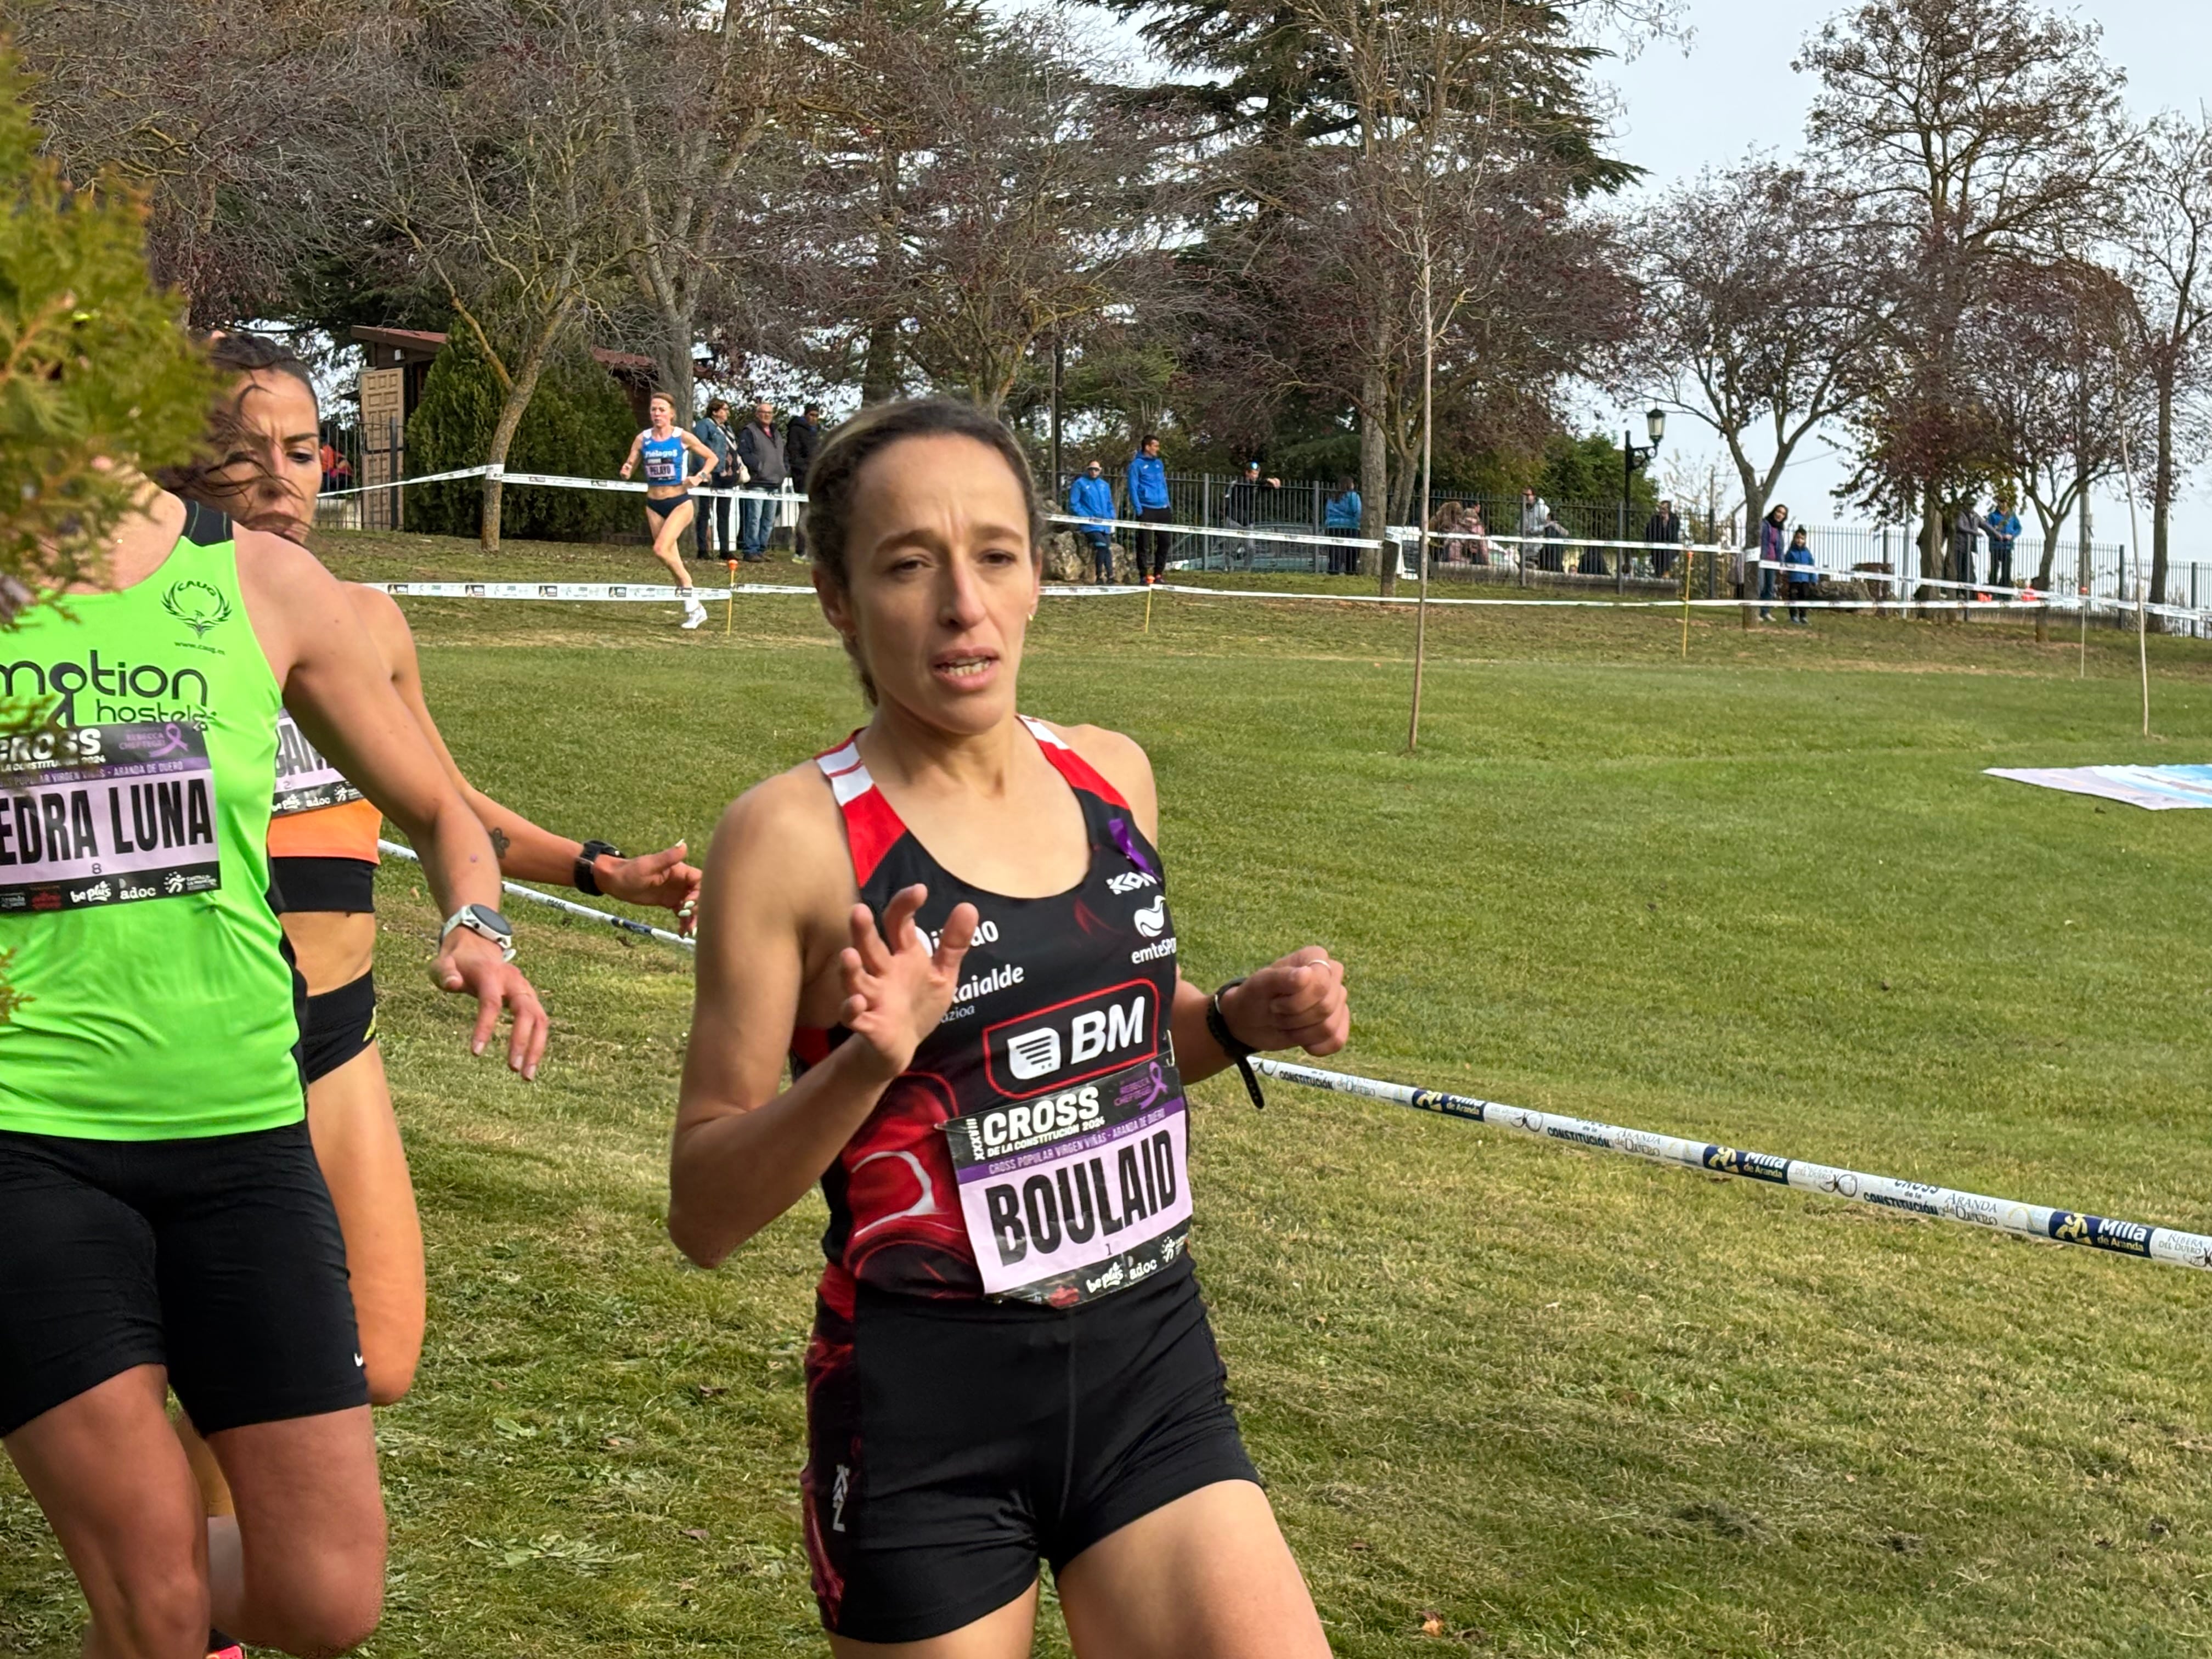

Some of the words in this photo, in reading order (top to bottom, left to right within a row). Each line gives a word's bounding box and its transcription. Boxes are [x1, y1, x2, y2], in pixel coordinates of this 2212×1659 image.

[178, 580, 216, 596] CAUG
[109, 779, 213, 854] LUNA
[92, 863, 102, 874] 8
[120, 887, 156, 900] adoc
[1070, 996, 1146, 1065] BM
[1279, 1070, 1334, 1091] CONSTITUCIÓN
[983, 1086, 1099, 1146] CROSS
[1457, 1103, 1480, 1115] Aranda
[987, 1147, 1001, 1158] DE
[1002, 1143, 1014, 1154] LA
[1014, 1122, 1080, 1150] CONSTITUCIÓN
[1547, 1126, 1611, 1149] CONSTITUCIÓN
[989, 1159, 1015, 1175] CROSS
[1018, 1149, 1053, 1167] POPULAR
[1055, 1141, 1083, 1158] VIRGEN
[1745, 1152, 1787, 1169] Milla
[1743, 1163, 1754, 1172] de
[1756, 1165, 1783, 1178] Aranda
[985, 1129, 1177, 1267] BOULAID
[1863, 1192, 1939, 1216] CONSTITUCIÓN
[1945, 1193, 1997, 1213] ARANDA
[2097, 1218, 2147, 1242] Milla
[1106, 1244, 1112, 1256] 1
[2097, 1234, 2109, 1245] de
[2111, 1238, 2145, 1252] Aranda
[2158, 1240, 2172, 1250] DEL
[2168, 1233, 2203, 1248] RIBERA
[1129, 1259, 1157, 1280] adoc
